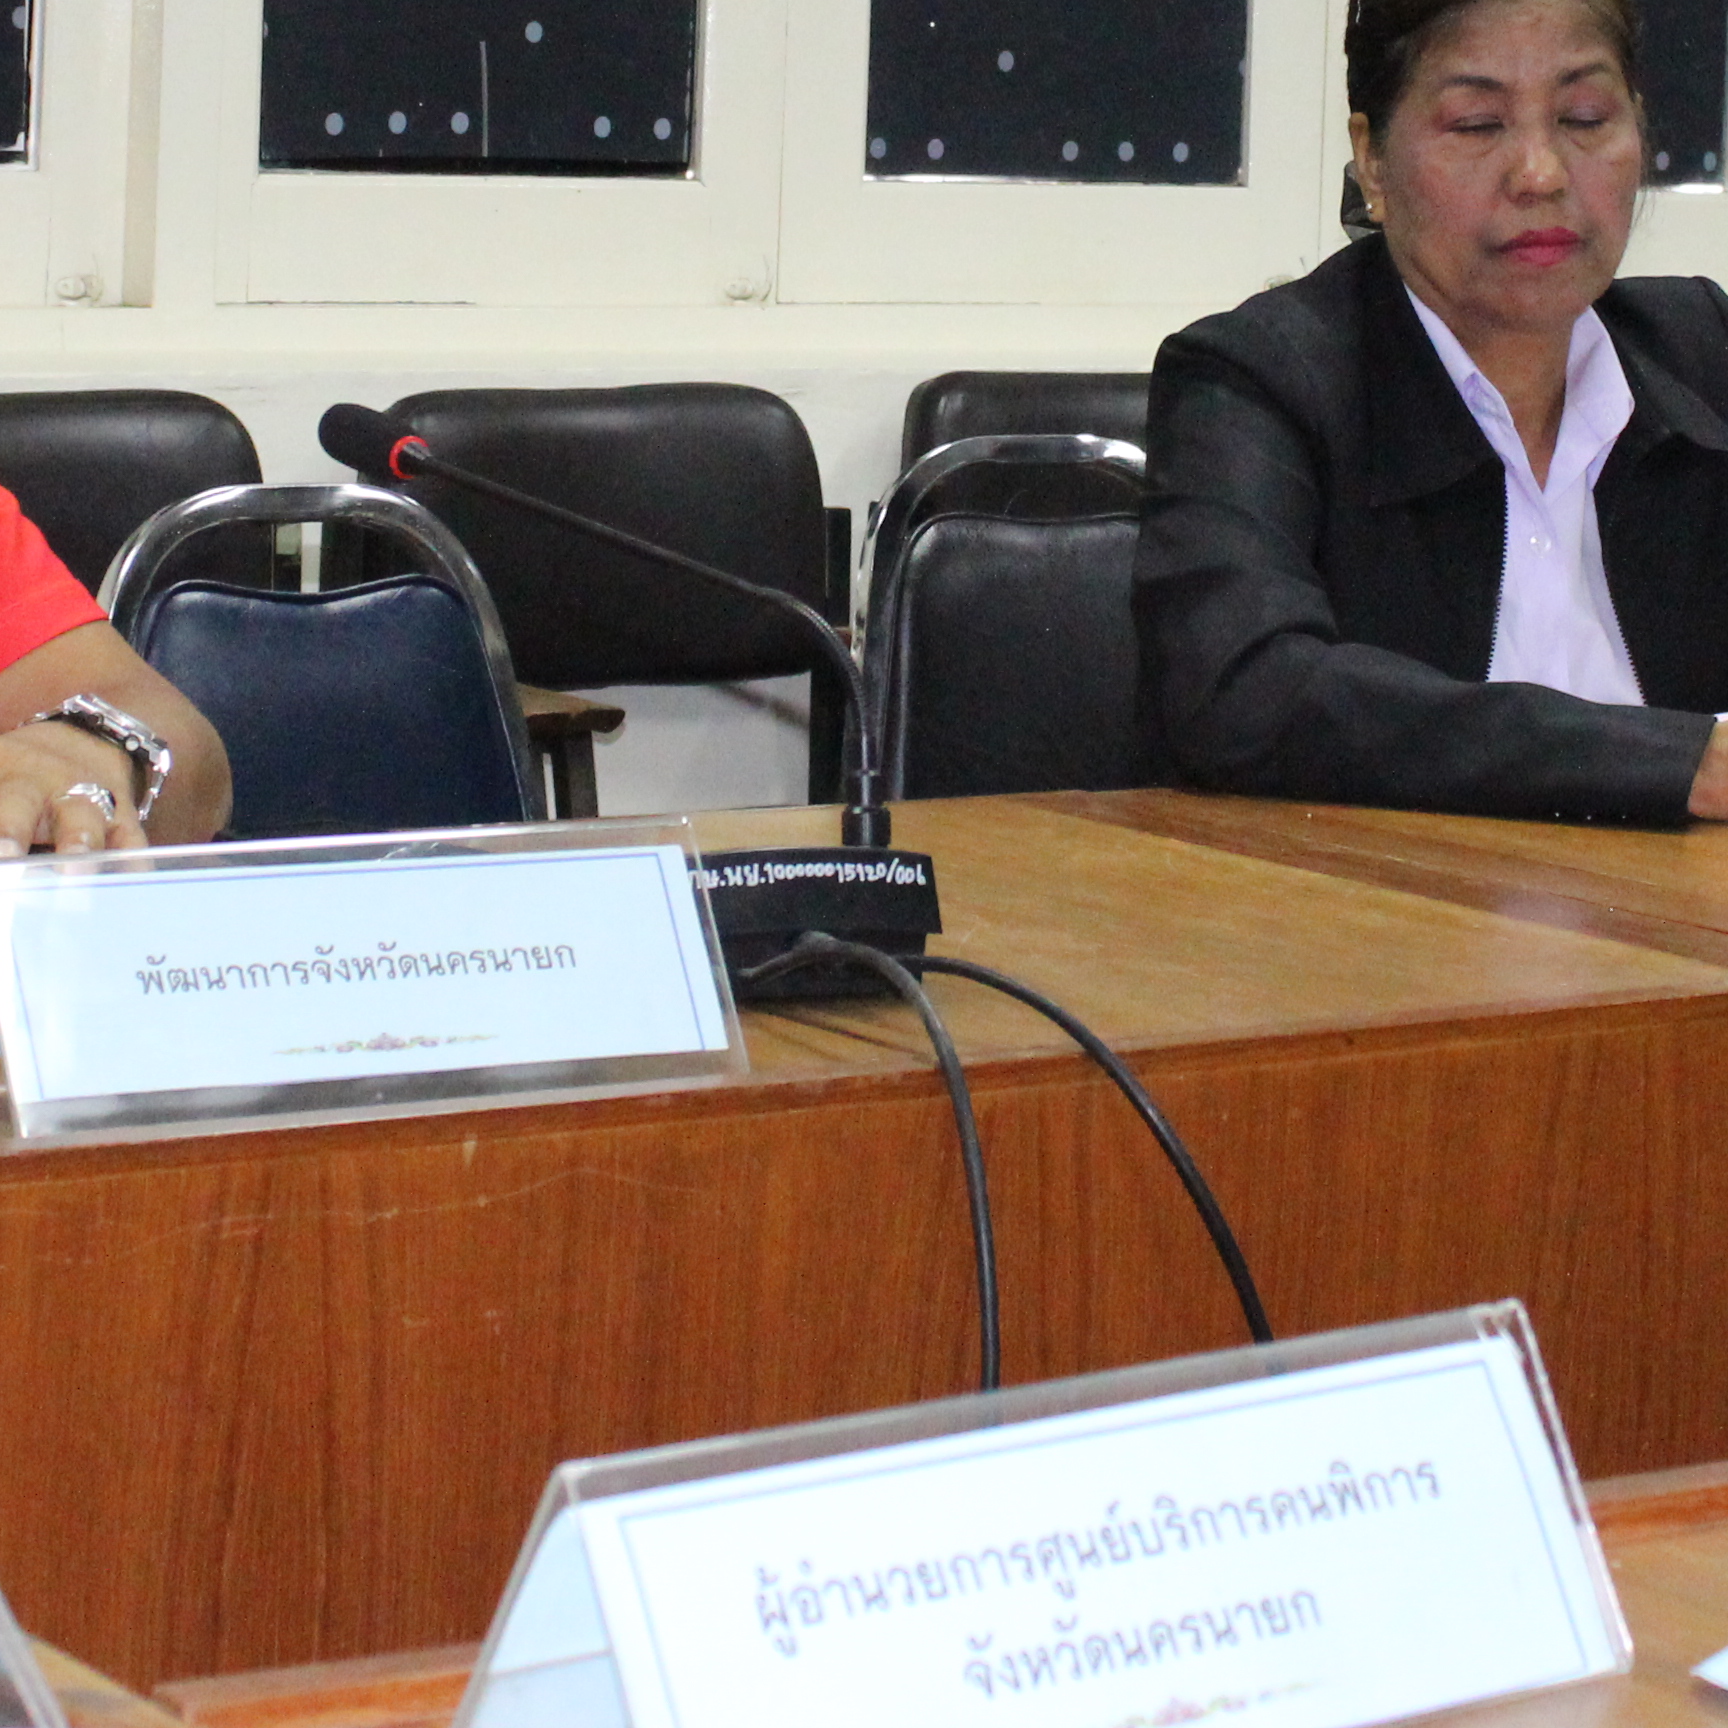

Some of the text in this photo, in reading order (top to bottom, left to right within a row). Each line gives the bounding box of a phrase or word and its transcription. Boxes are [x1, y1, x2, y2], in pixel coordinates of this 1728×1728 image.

[135, 941, 577, 996] พัฒนาการจังหวัดนครนายก
[754, 1458, 1440, 1659] ผู้อำนวยการศูนย์บริการคนพิการ
[964, 1585, 1325, 1701] จังหวัดนครนายก
